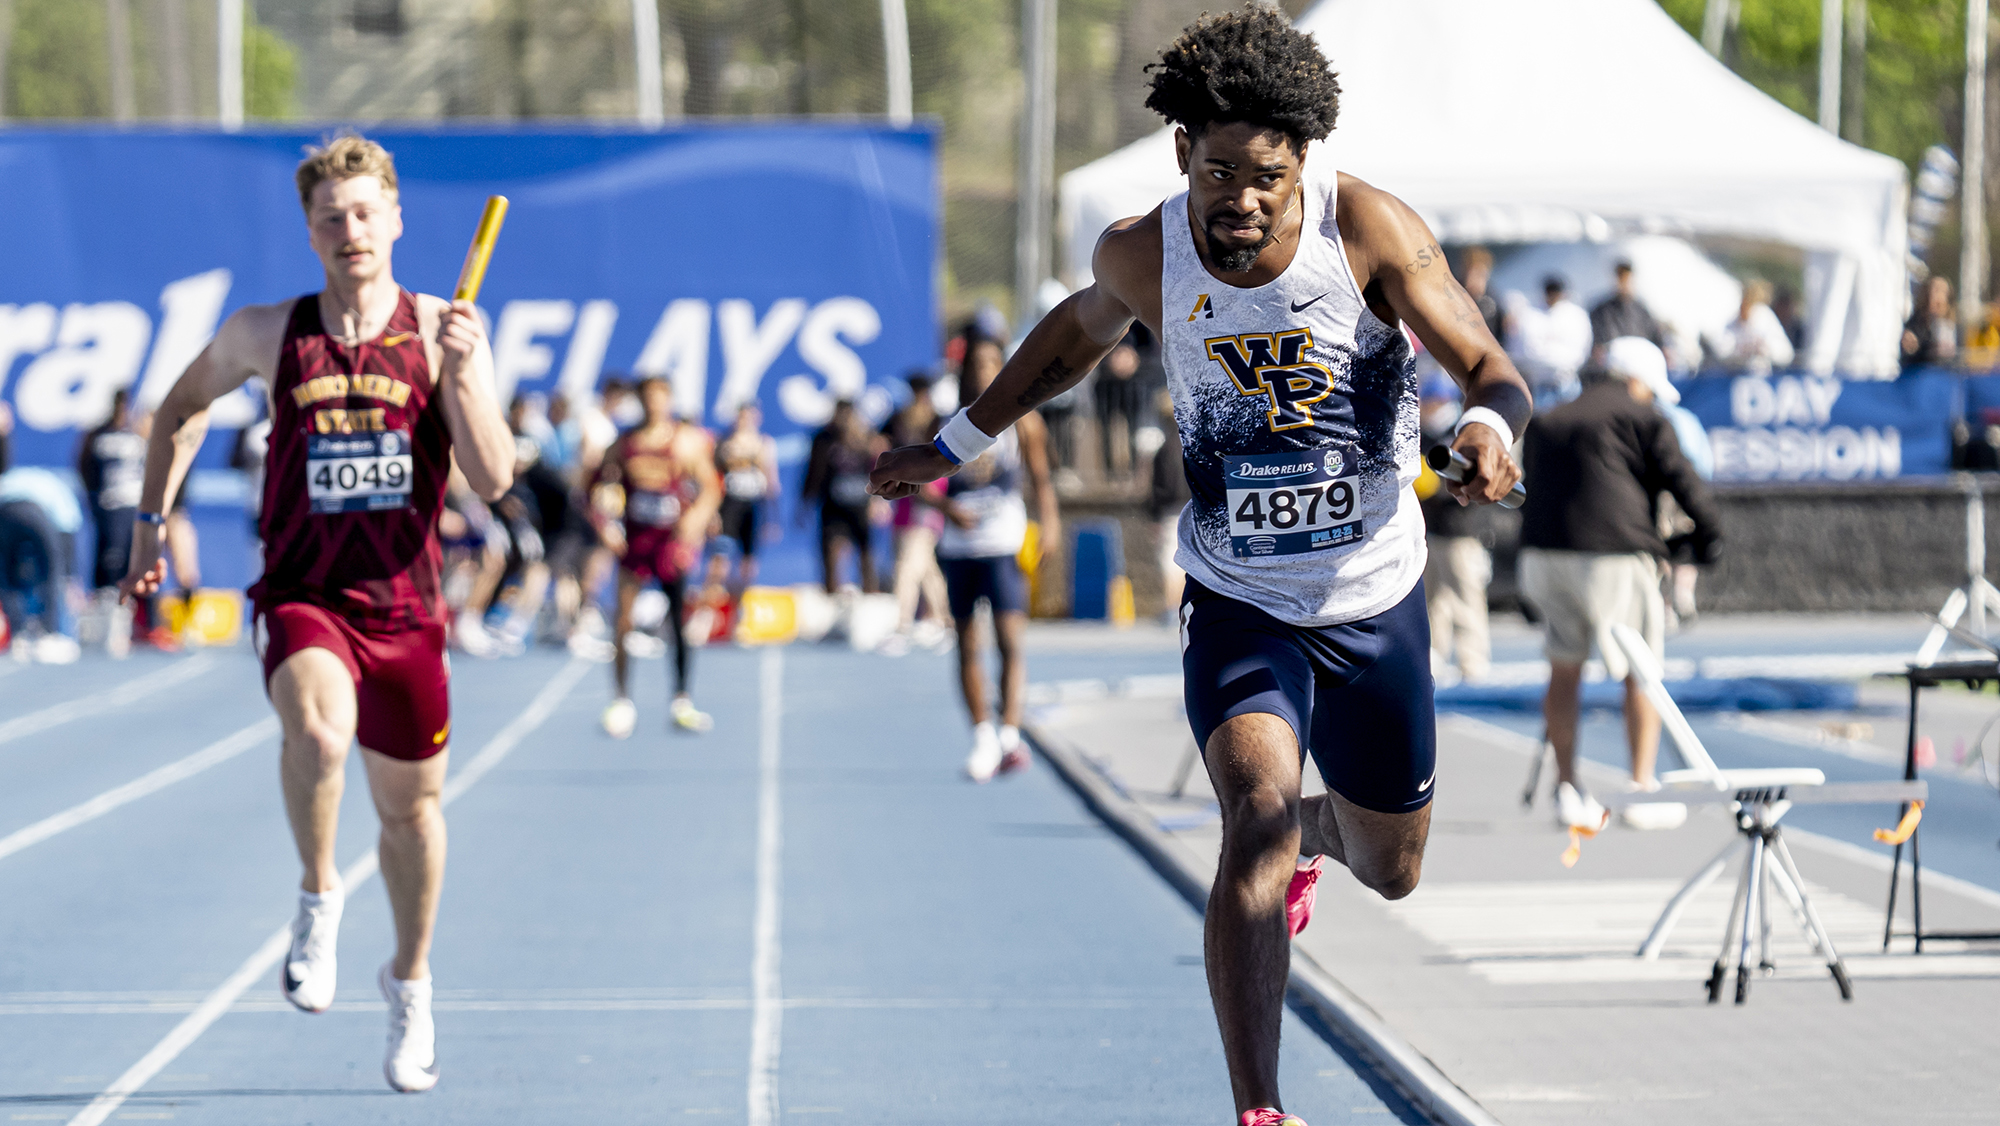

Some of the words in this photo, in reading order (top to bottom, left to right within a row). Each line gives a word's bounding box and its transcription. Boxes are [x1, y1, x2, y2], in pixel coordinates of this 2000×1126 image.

[476, 297, 882, 426] ELAYS
[1730, 375, 1842, 427] DAY
[315, 408, 386, 434] STATE
[1239, 462, 1280, 476] Drake
[1280, 462, 1315, 475] RELAYS
[1708, 425, 1901, 481] ESSION
[314, 461, 406, 491] 4049
[1235, 481, 1355, 530] 4879
[1311, 531, 1332, 543] APRIL
